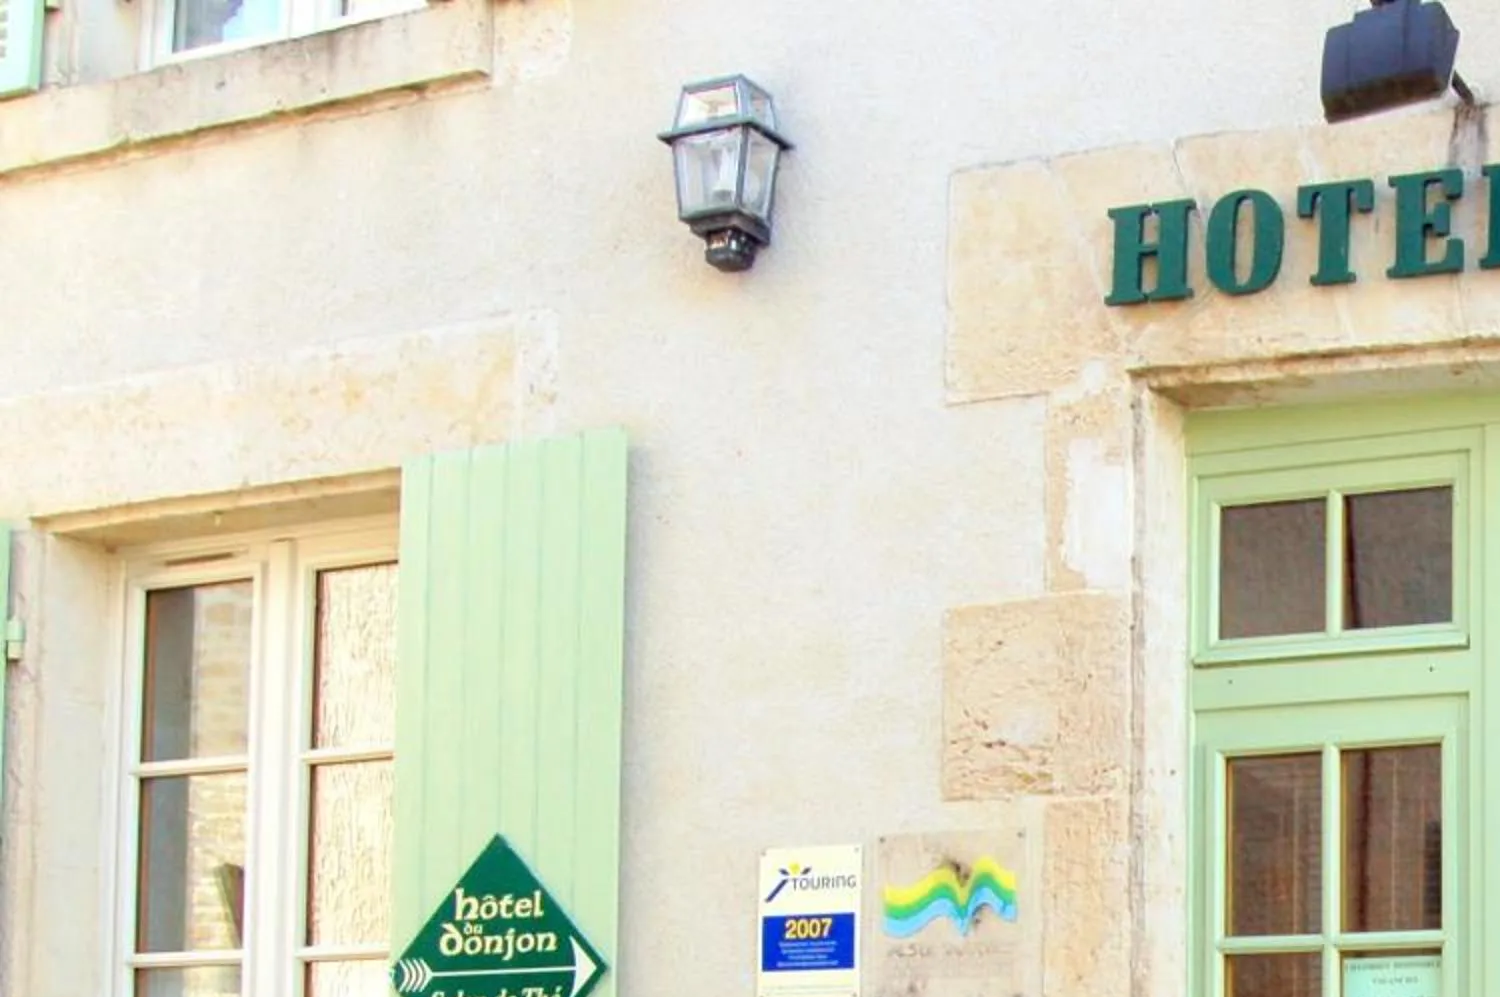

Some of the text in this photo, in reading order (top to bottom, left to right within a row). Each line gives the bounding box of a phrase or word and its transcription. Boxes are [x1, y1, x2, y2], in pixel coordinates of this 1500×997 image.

[455, 888, 544, 920] hôtel
[439, 922, 557, 960] donjon
[463, 922, 483, 934] du
[785, 917, 832, 939] 2007
